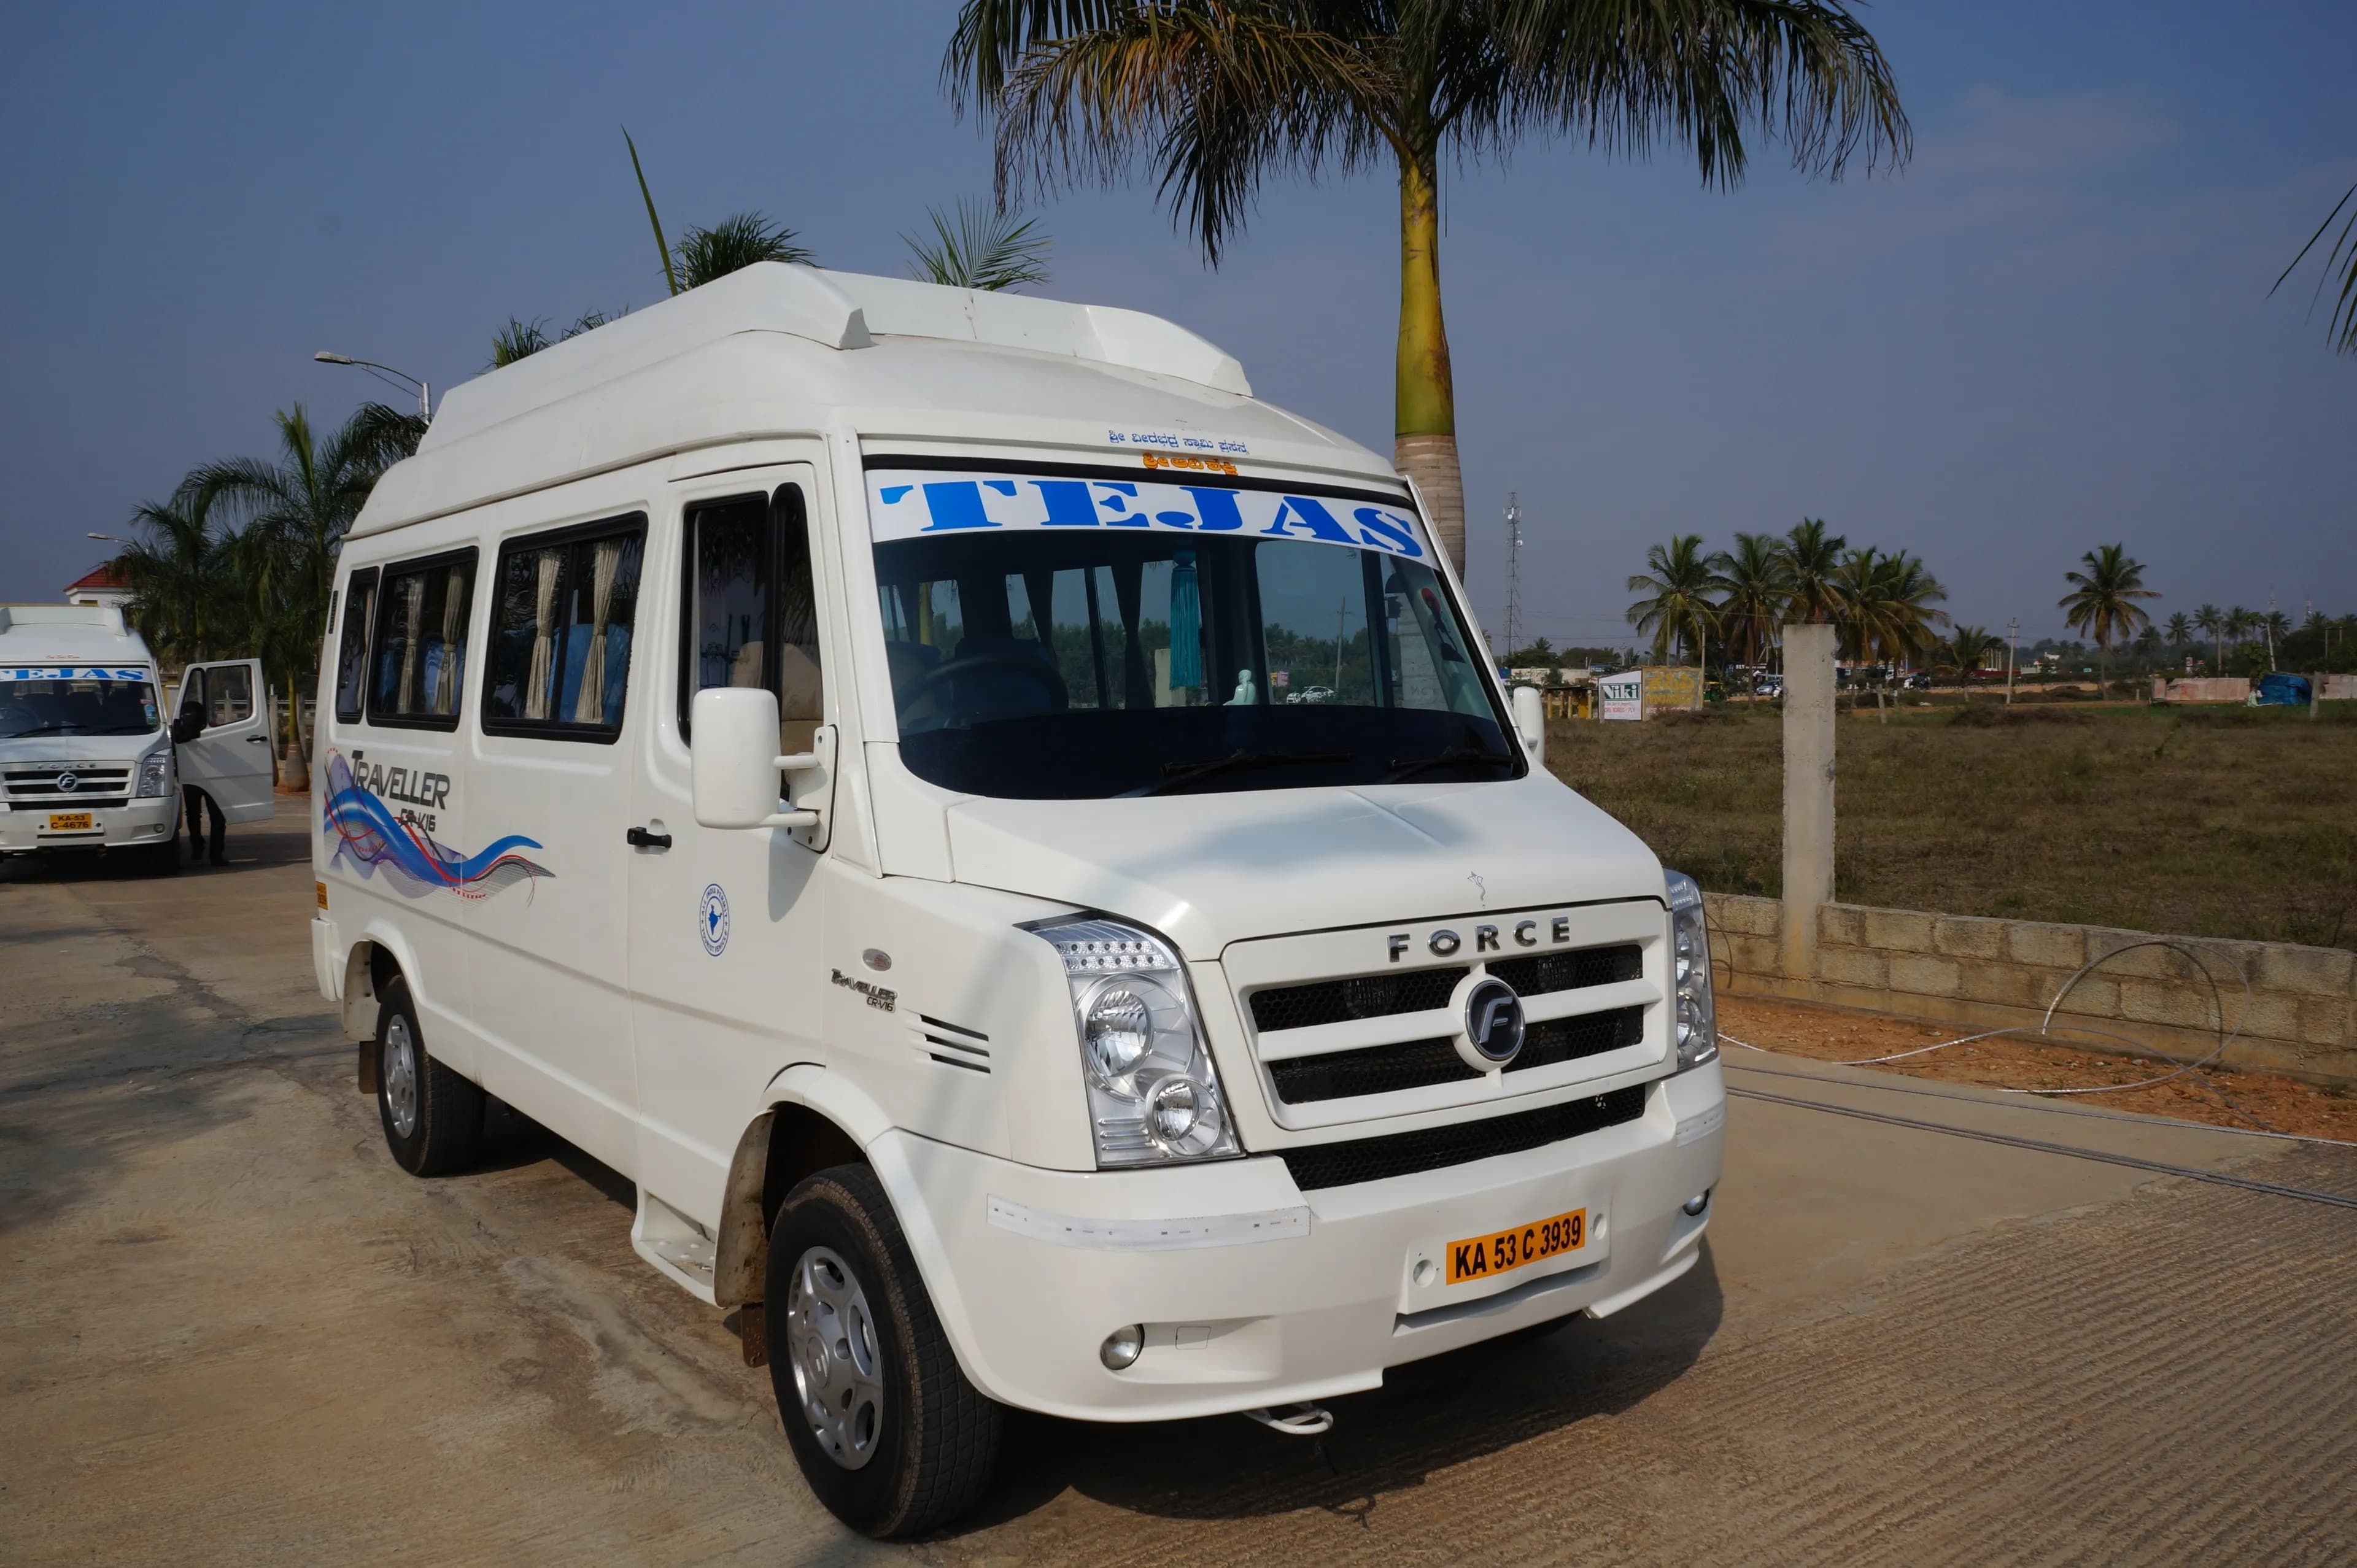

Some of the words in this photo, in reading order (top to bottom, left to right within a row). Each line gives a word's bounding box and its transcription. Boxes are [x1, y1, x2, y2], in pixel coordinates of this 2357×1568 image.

[1109, 430, 1126, 444] ಶ್ರೀ
[1132, 432, 1179, 448] ವೀರಭದ್ರ
[1142, 453, 1169, 470] ಶ್ರೀ
[880, 479, 1423, 557] TEJAS
[1601, 684, 1638, 700] Niki
[352, 750, 450, 810] TRAVELLER
[50, 821, 90, 829] C-4676
[1387, 916, 1570, 962] FORCE
[1456, 1242, 1487, 1278] KA
[1494, 1234, 1516, 1269] 53
[1523, 1229, 1535, 1260] C
[1540, 1215, 1581, 1256] 3939
